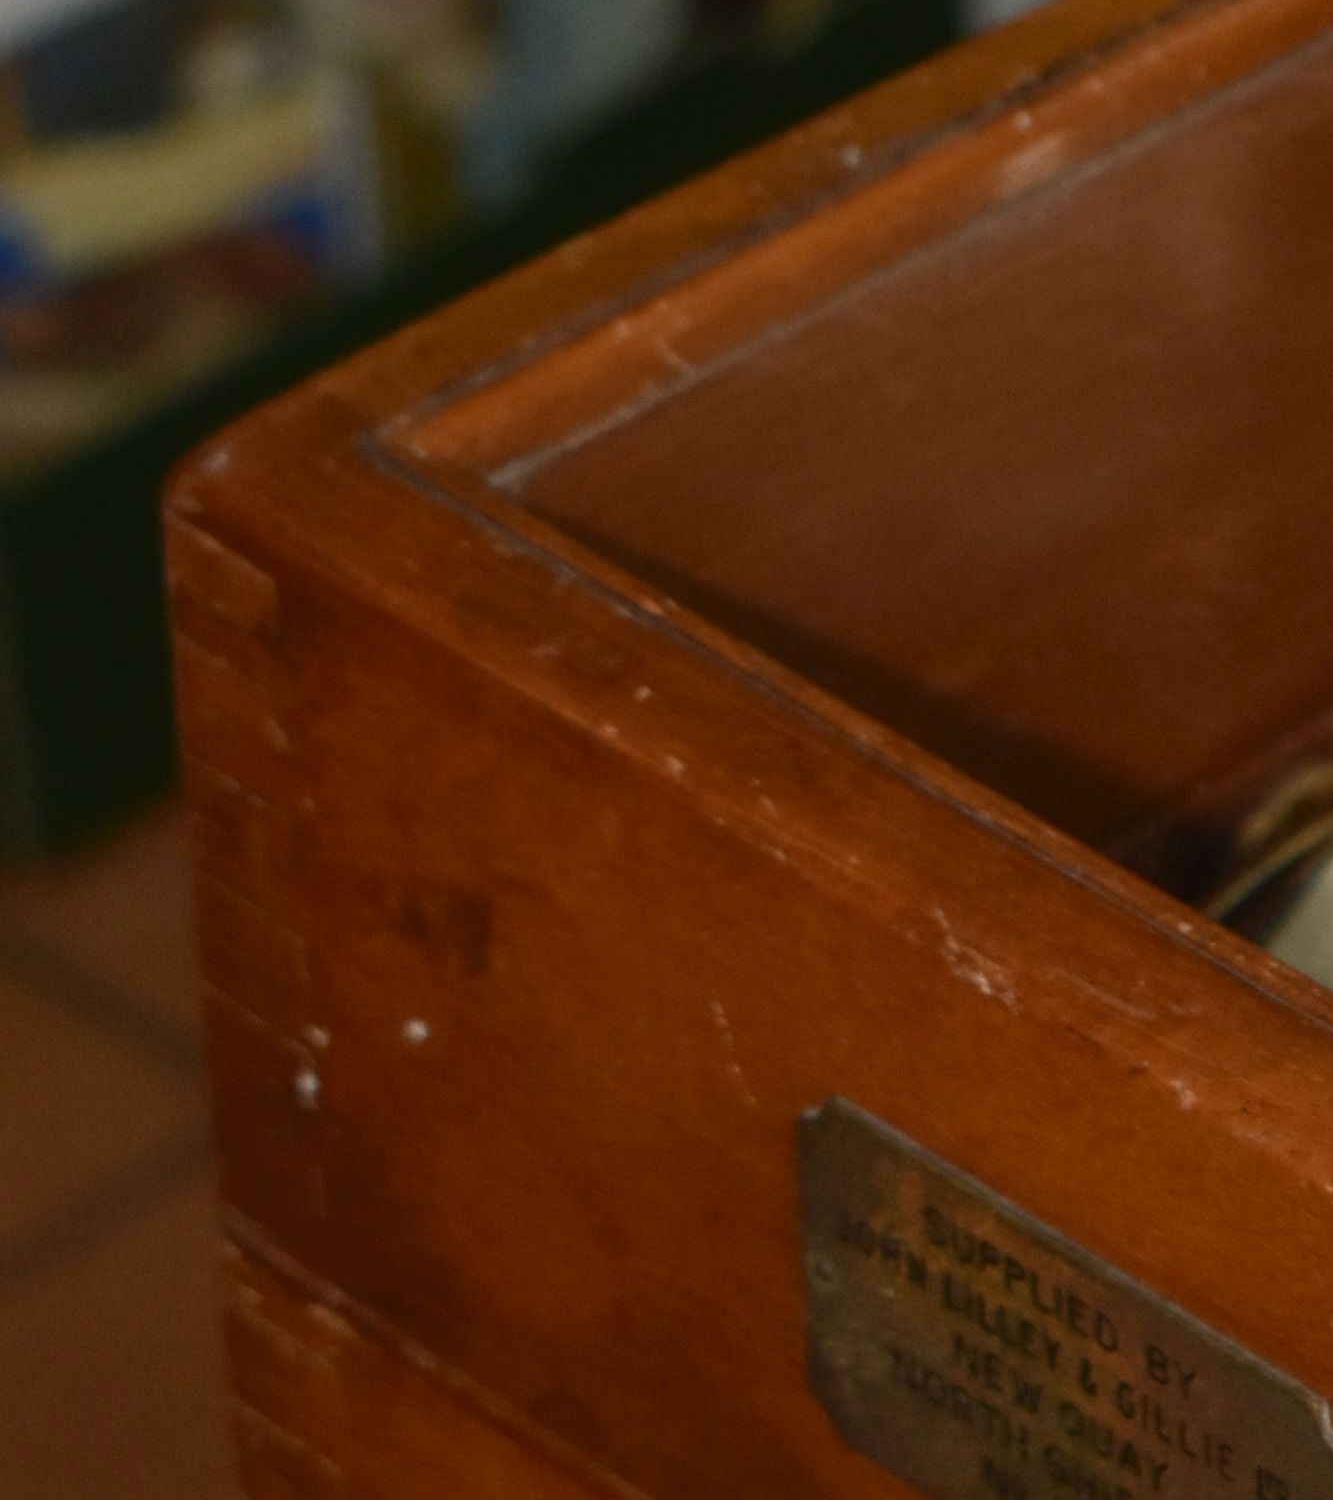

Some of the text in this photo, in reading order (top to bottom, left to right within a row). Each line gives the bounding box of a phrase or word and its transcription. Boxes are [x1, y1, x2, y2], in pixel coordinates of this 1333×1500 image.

[1144, 1339, 1196, 1405] BY
[1058, 1394, 1168, 1499] QUAY
[1115, 1376, 1236, 1486] GILLIE
